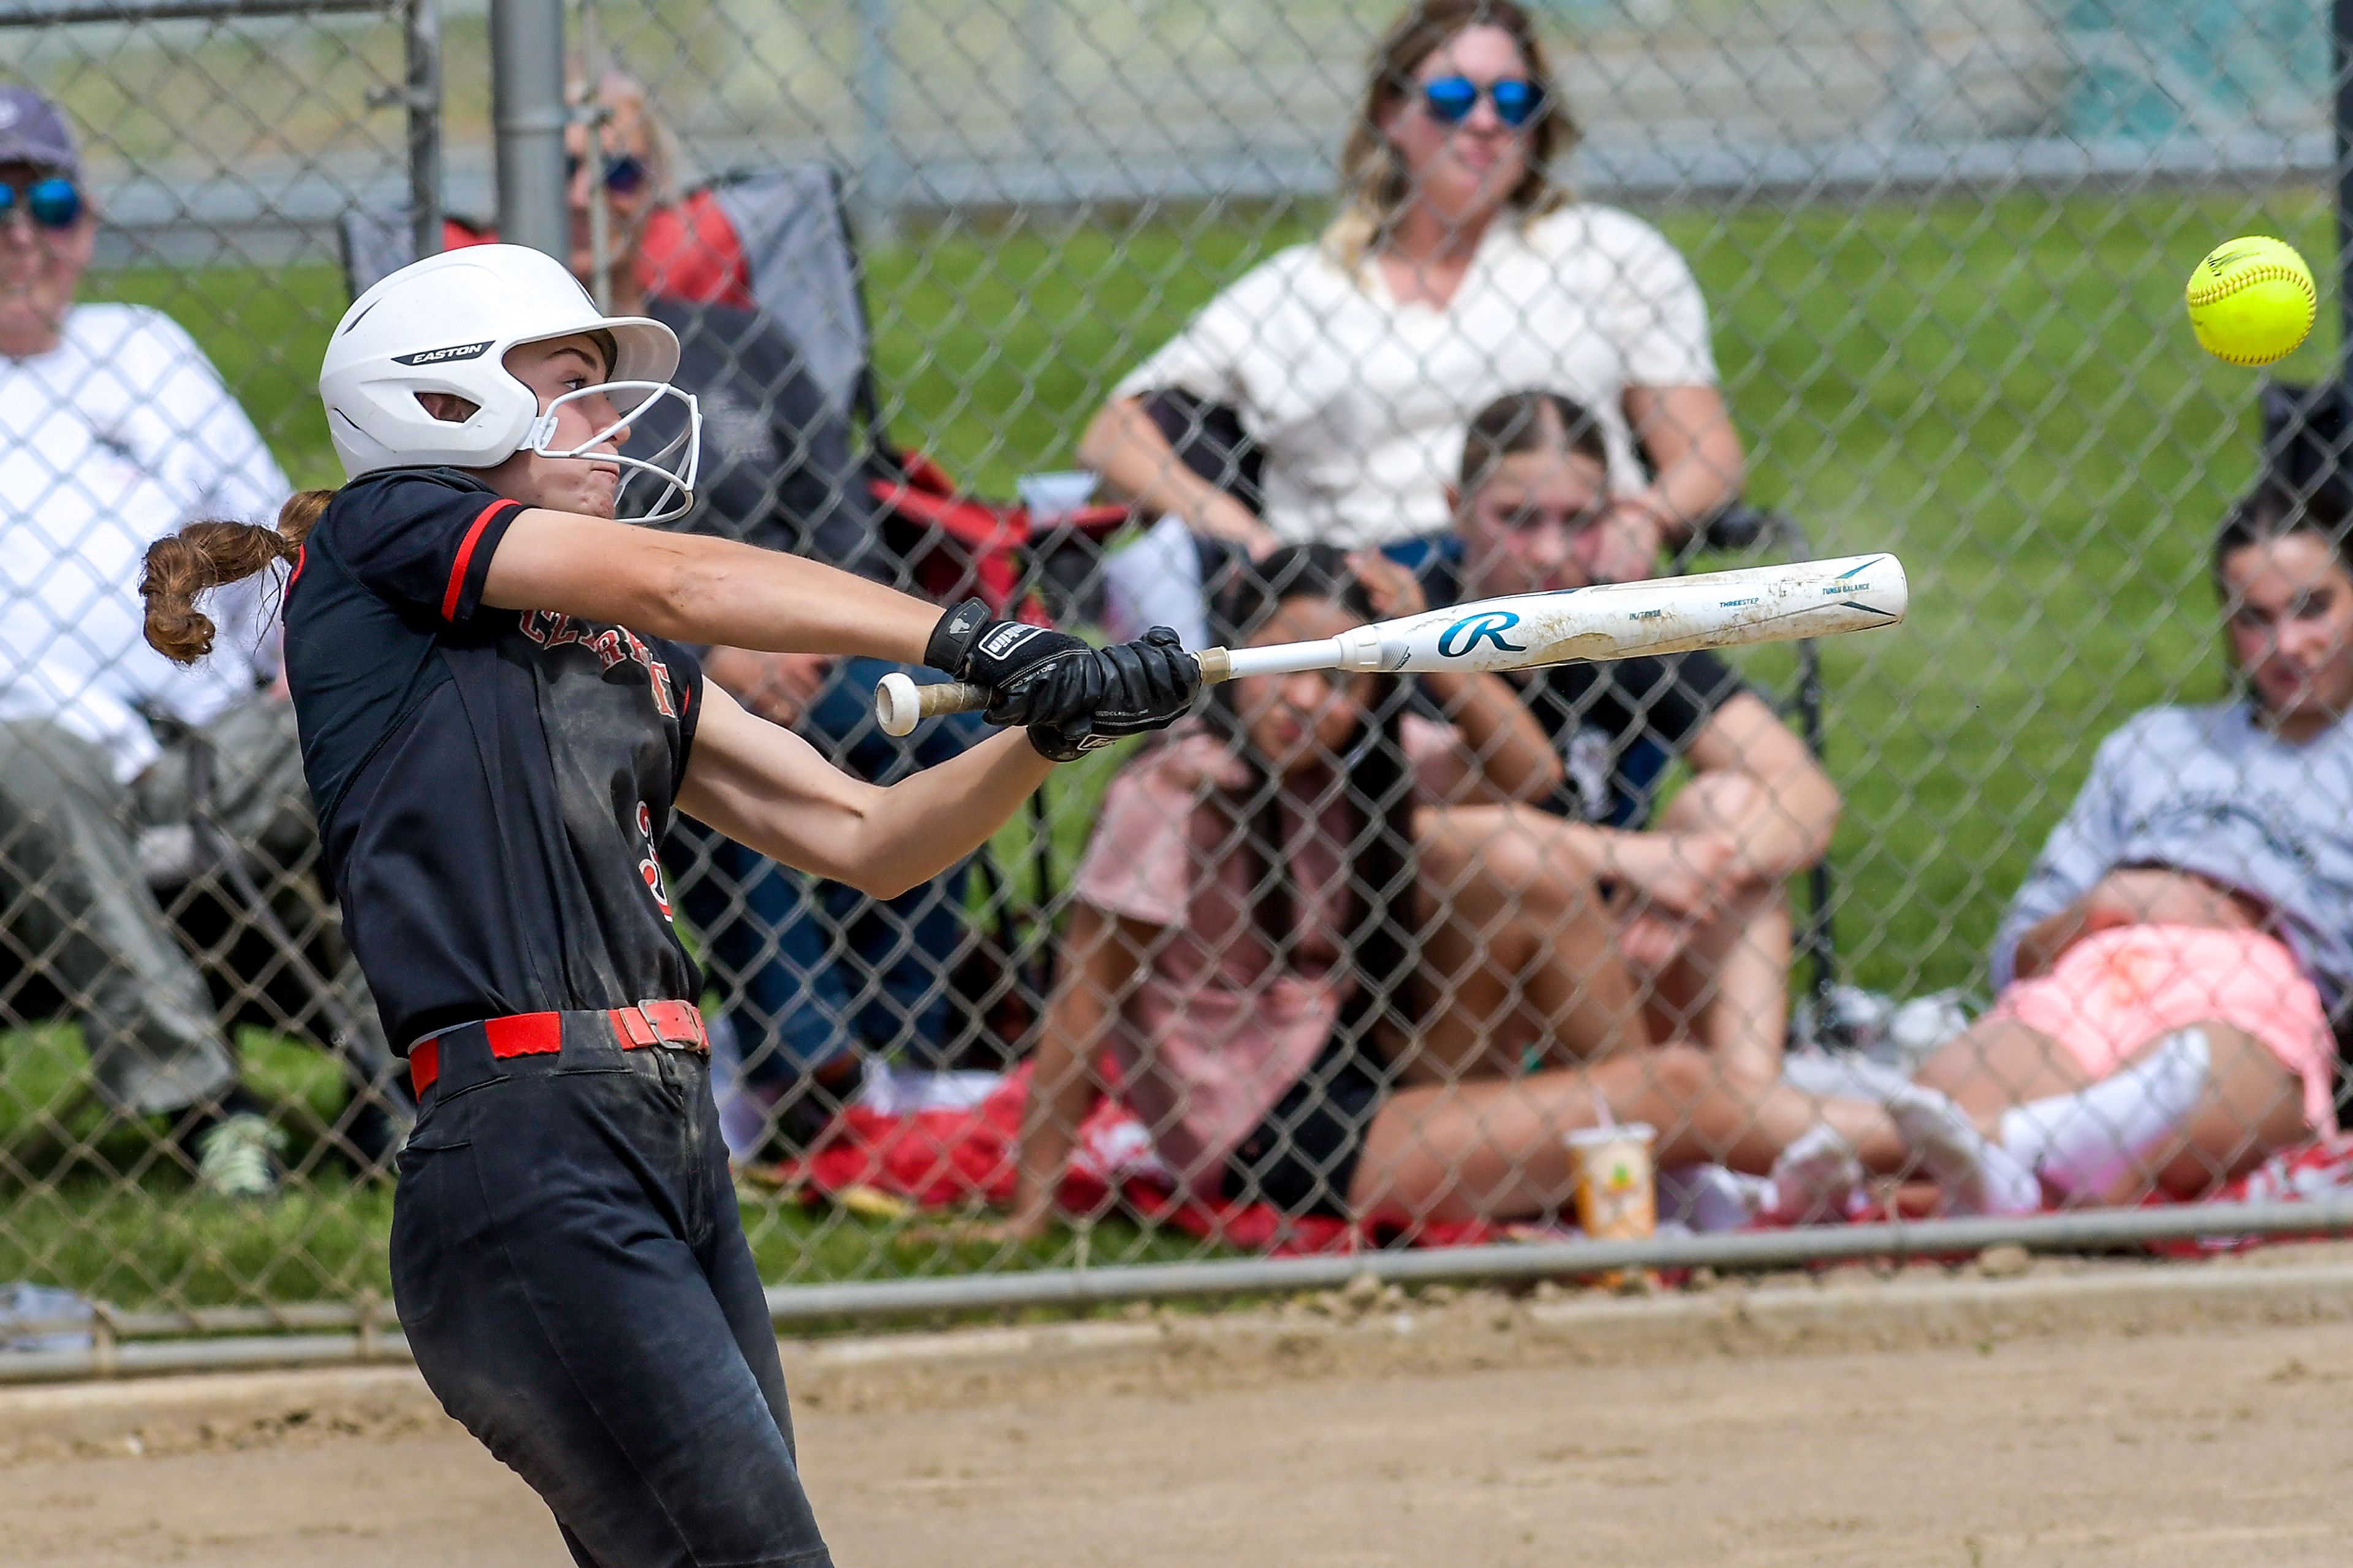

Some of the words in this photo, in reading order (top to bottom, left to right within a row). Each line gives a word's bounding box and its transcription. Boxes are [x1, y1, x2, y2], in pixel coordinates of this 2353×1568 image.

[412, 344, 482, 363] EASTON
[1822, 586, 1841, 595] TUNED
[1843, 583, 1870, 593] BALANCE
[1719, 597, 1759, 608] THREESTEP
[1438, 612, 1526, 657] R
